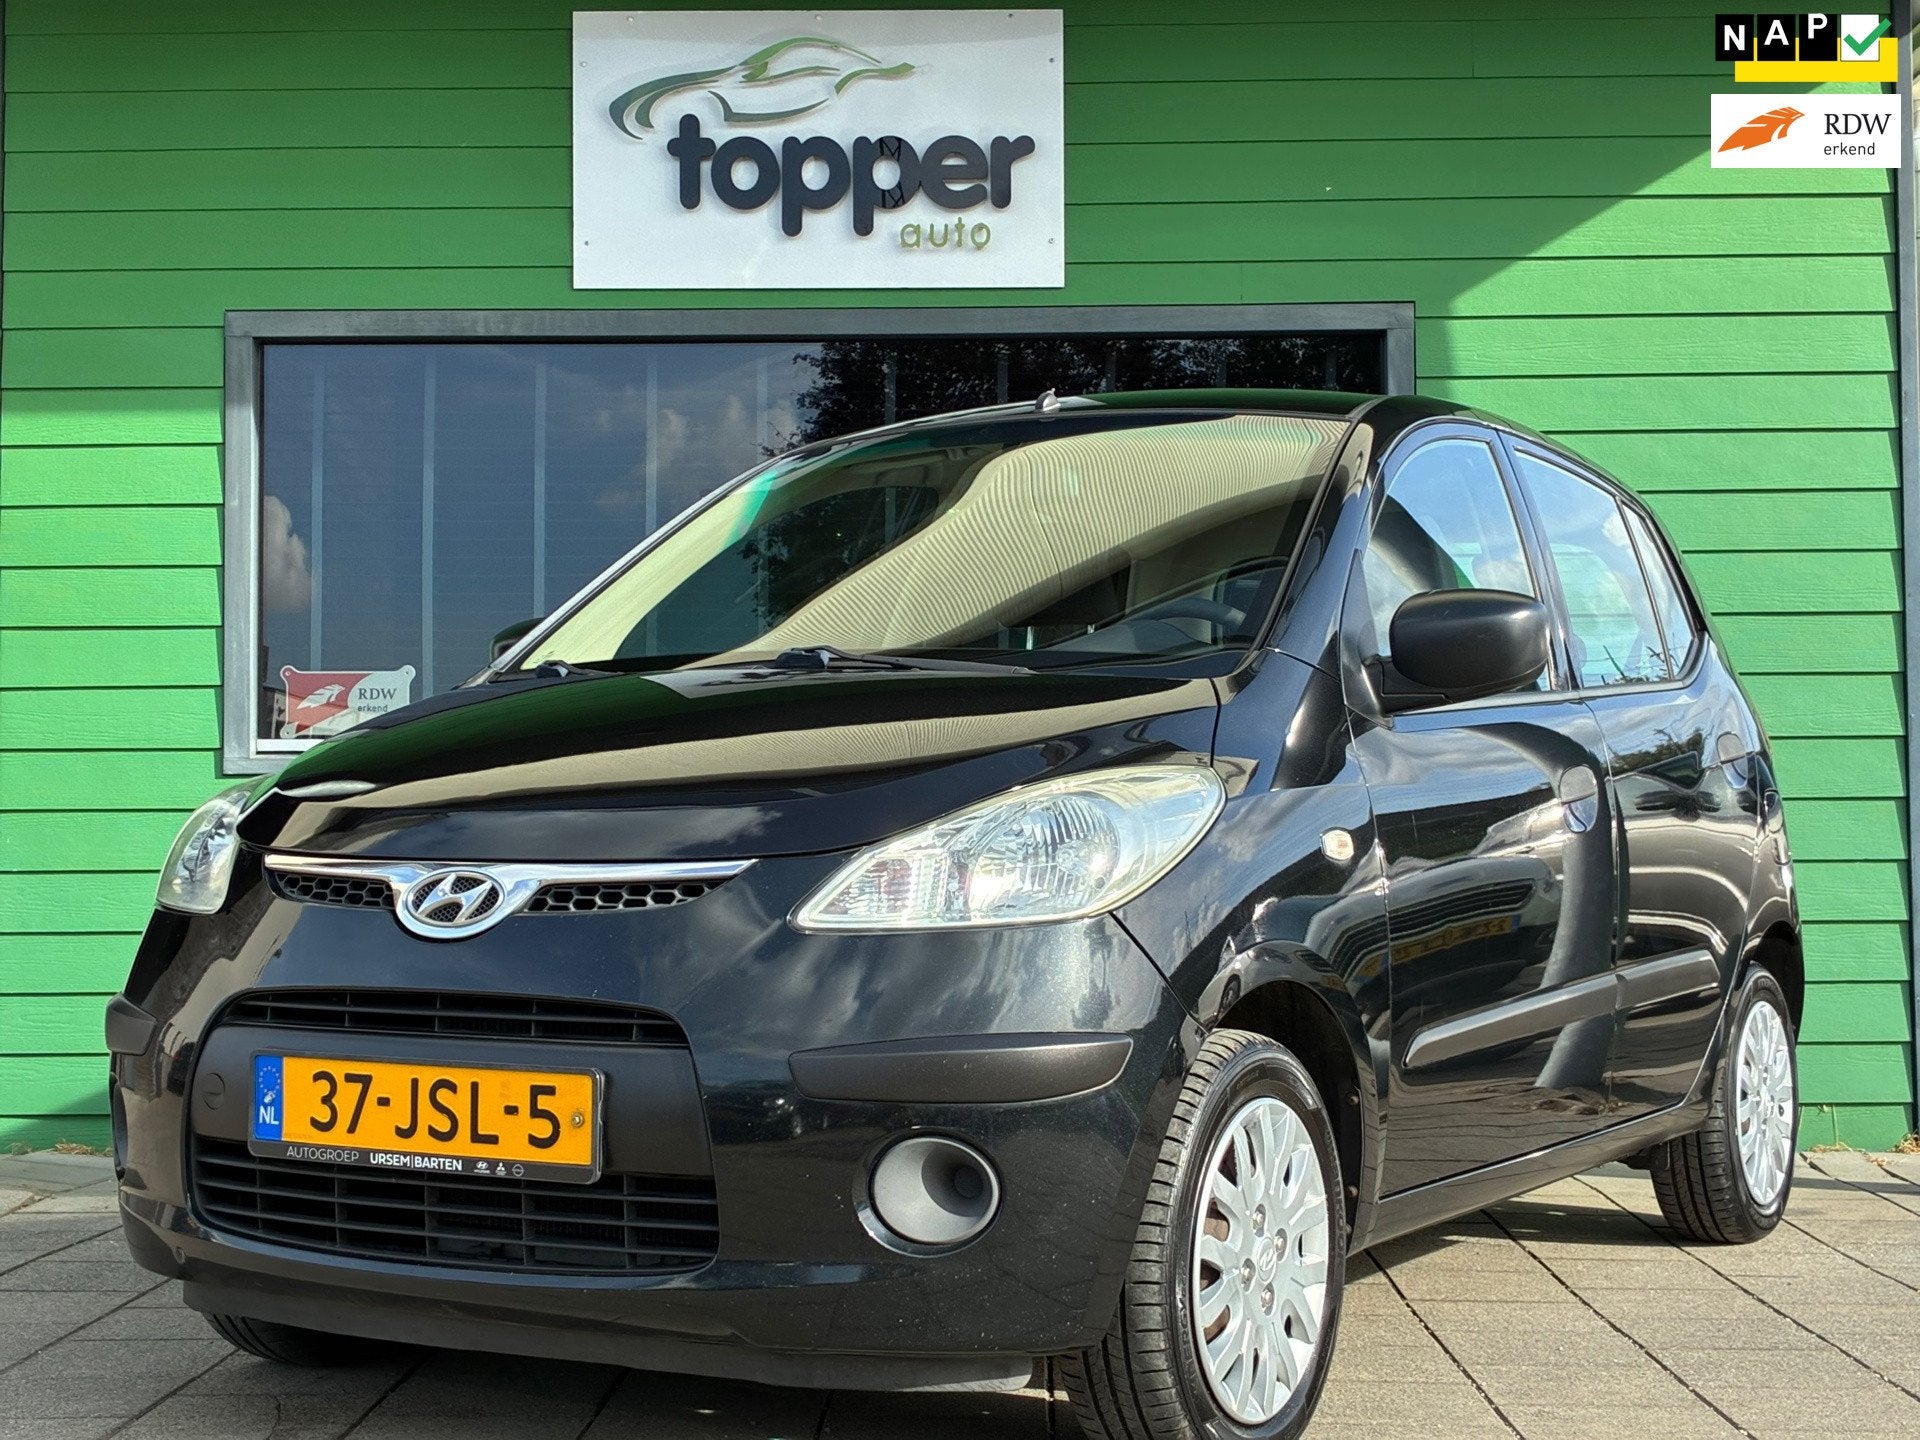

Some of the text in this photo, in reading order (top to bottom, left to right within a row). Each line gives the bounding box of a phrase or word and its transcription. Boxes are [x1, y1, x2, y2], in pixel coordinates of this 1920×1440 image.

[667, 113, 1036, 237] topper
[900, 217, 991, 248] auto
[358, 687, 397, 700] RDW
[357, 704, 388, 713] erkend
[259, 1106, 279, 1125] NL
[309, 1070, 561, 1149] 37-JSL-5
[287, 1146, 359, 1162] AUTOGROEP
